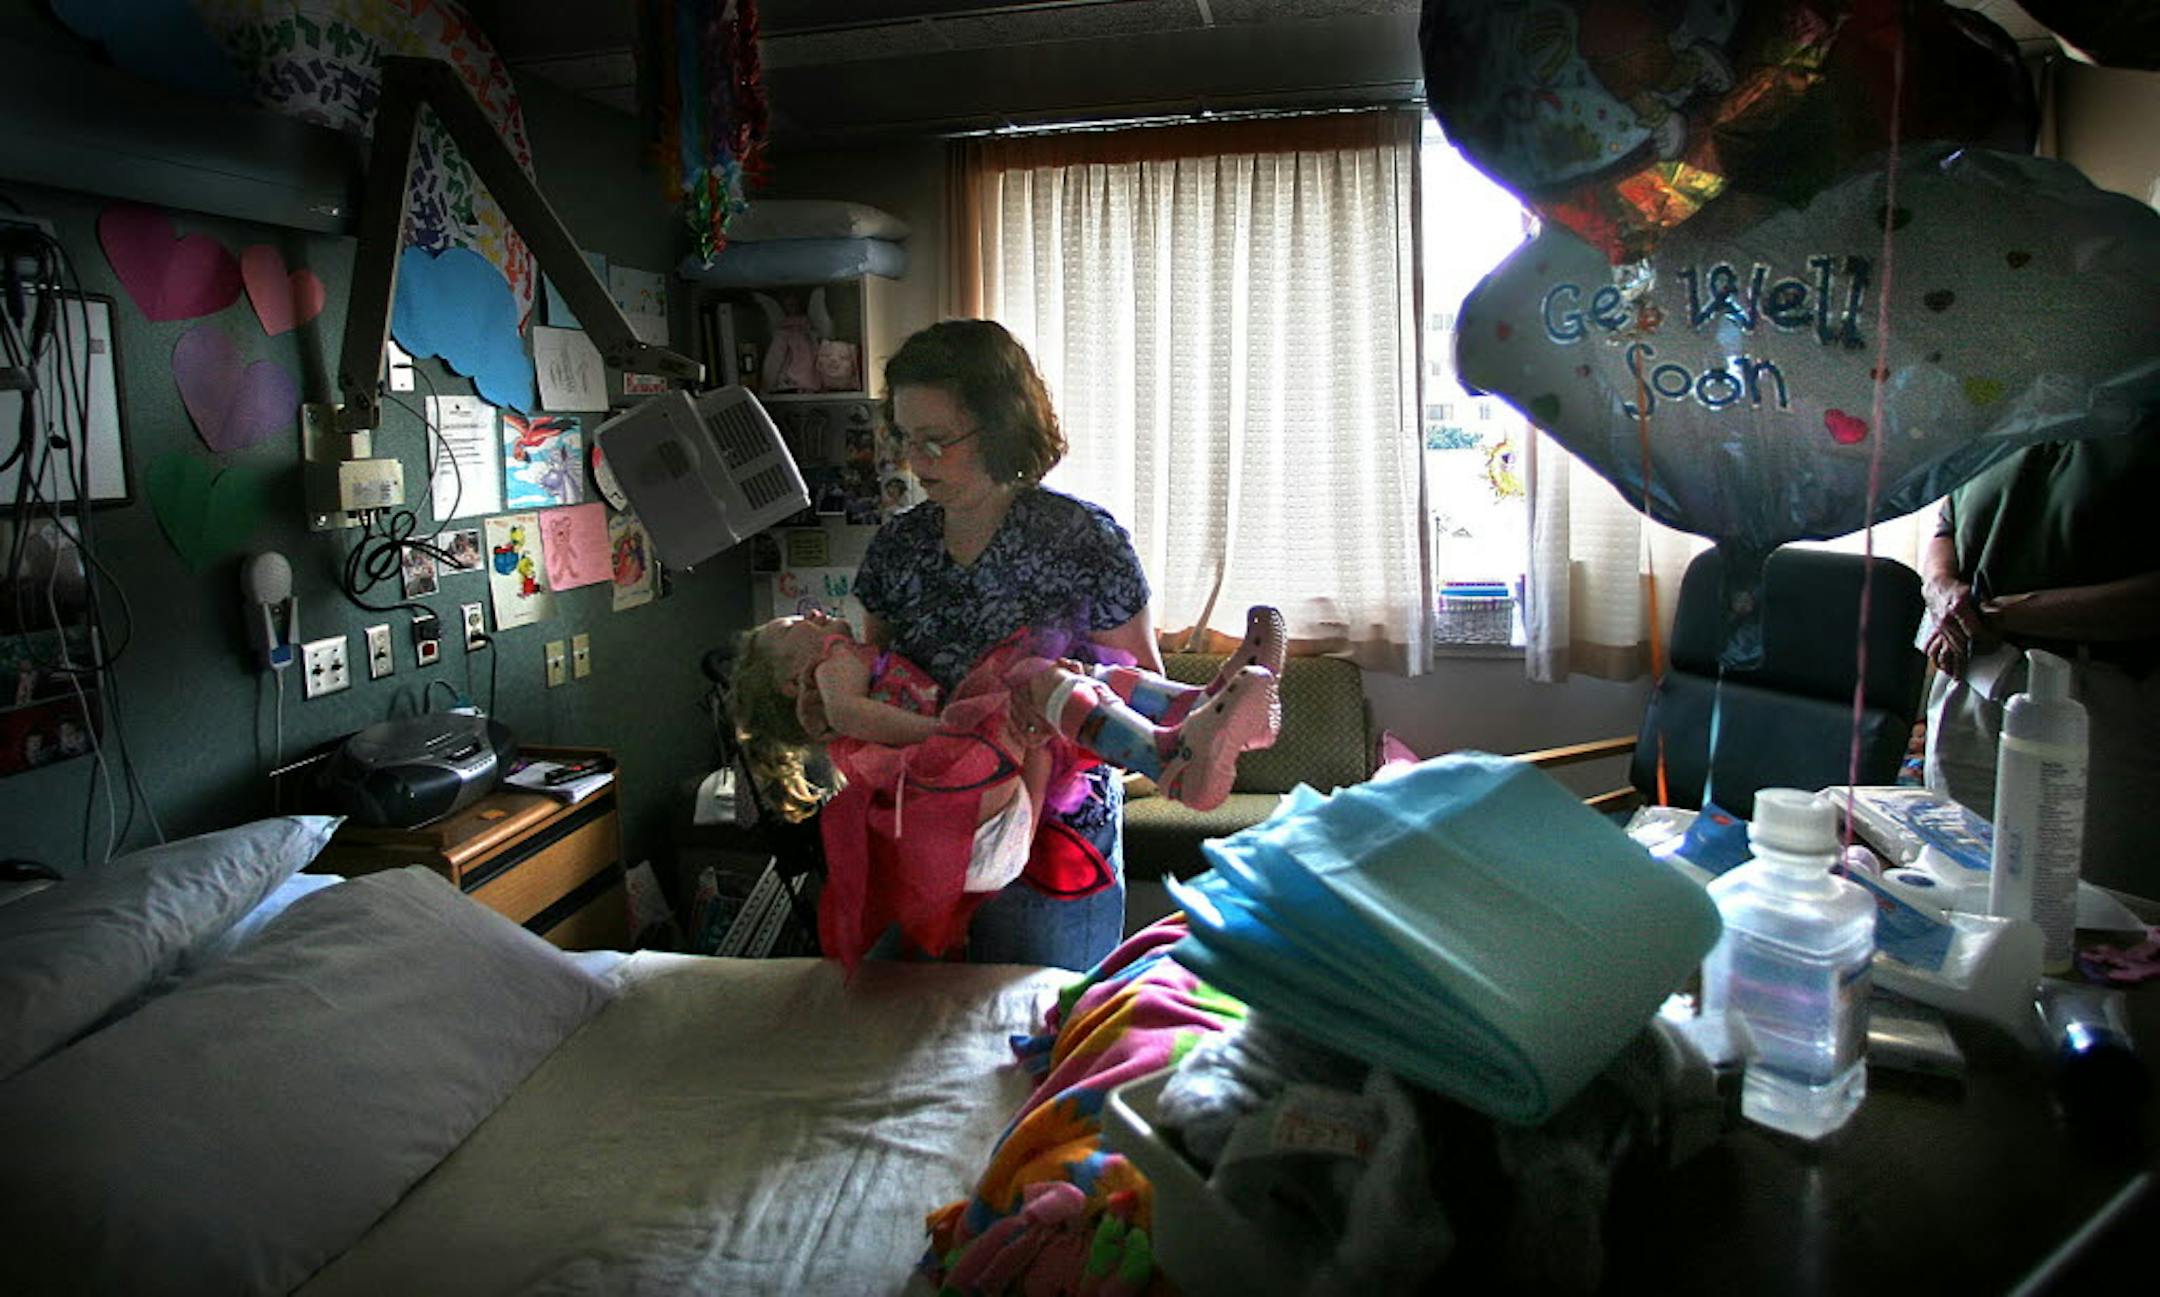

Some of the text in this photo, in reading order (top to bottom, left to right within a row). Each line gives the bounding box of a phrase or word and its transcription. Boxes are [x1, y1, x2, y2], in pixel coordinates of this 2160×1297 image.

[1541, 253, 1873, 350] Ge Well
[1622, 341, 1793, 421] Soon
